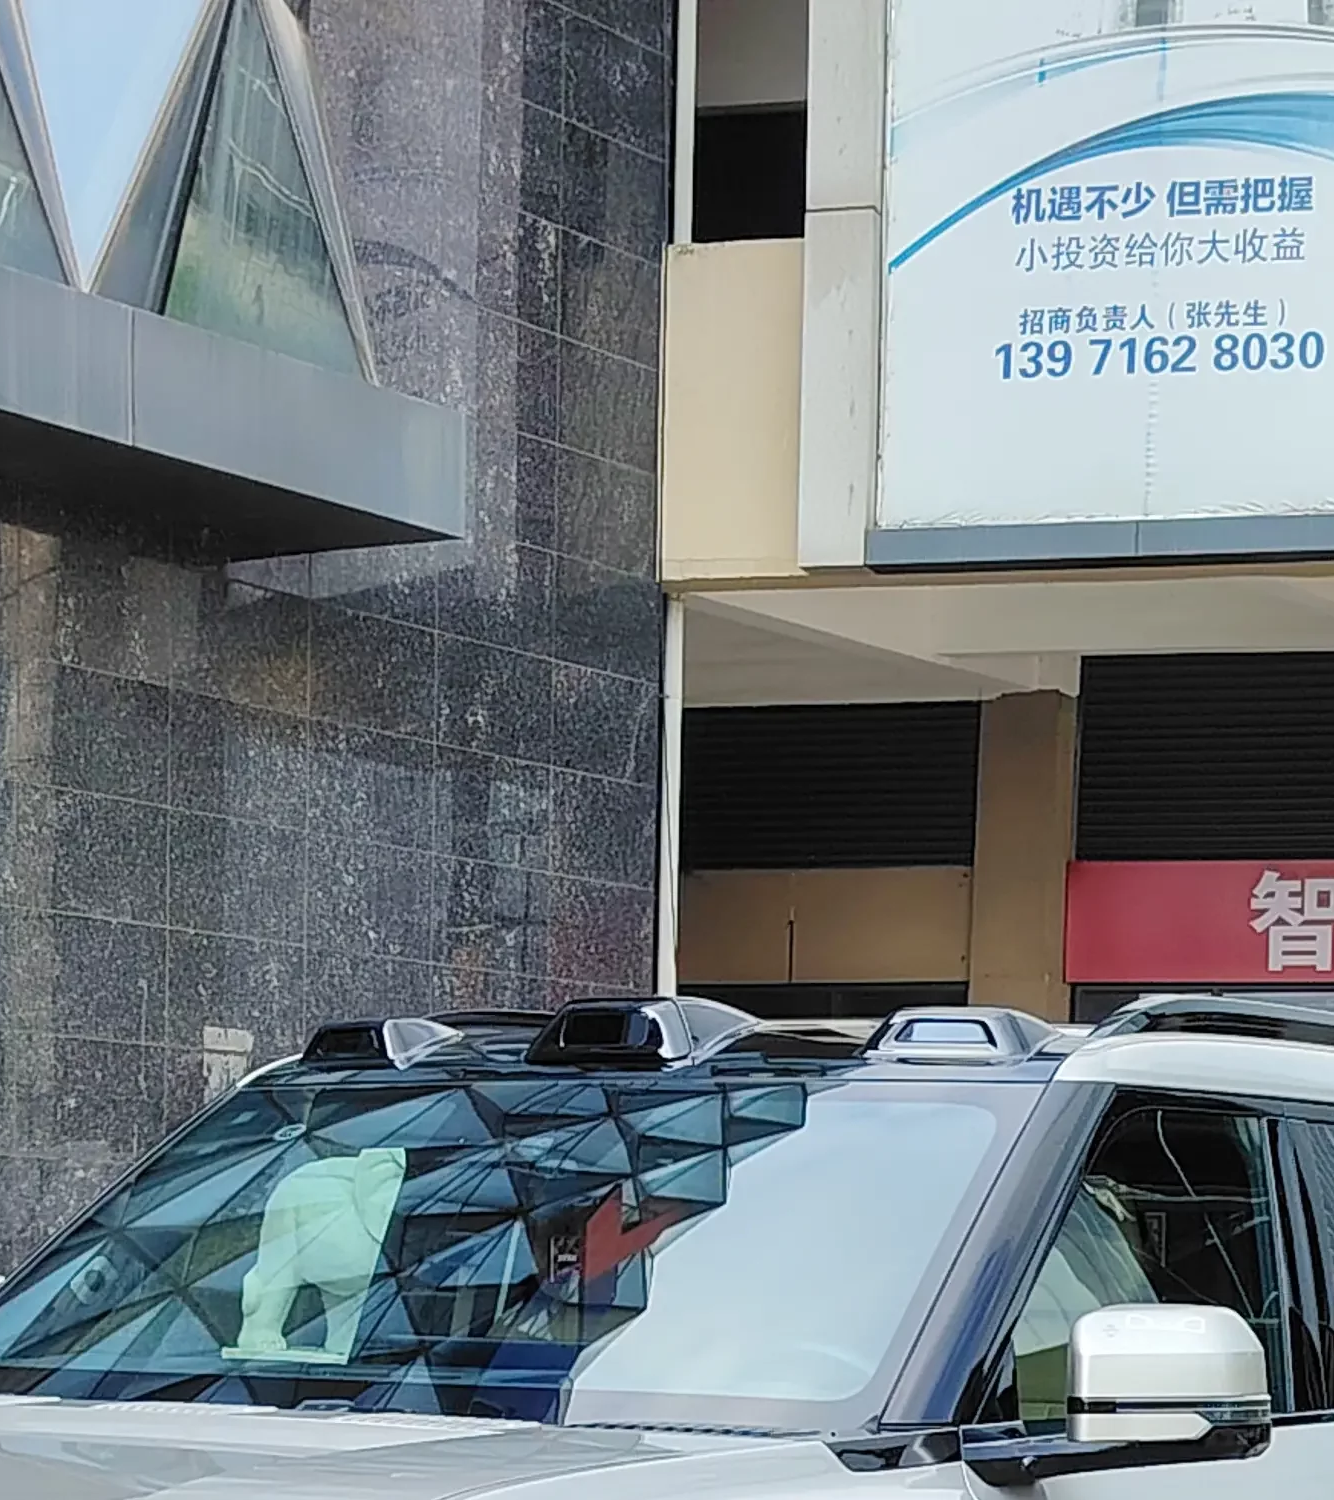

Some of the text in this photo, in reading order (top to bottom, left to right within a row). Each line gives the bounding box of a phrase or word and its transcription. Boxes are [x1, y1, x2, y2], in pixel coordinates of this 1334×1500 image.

[1012, 176, 1314, 225] 机遇不少 但需把握
[1015, 227, 1306, 272] 小投资给你大收益
[995, 330, 1325, 380] 139 7162 8030
